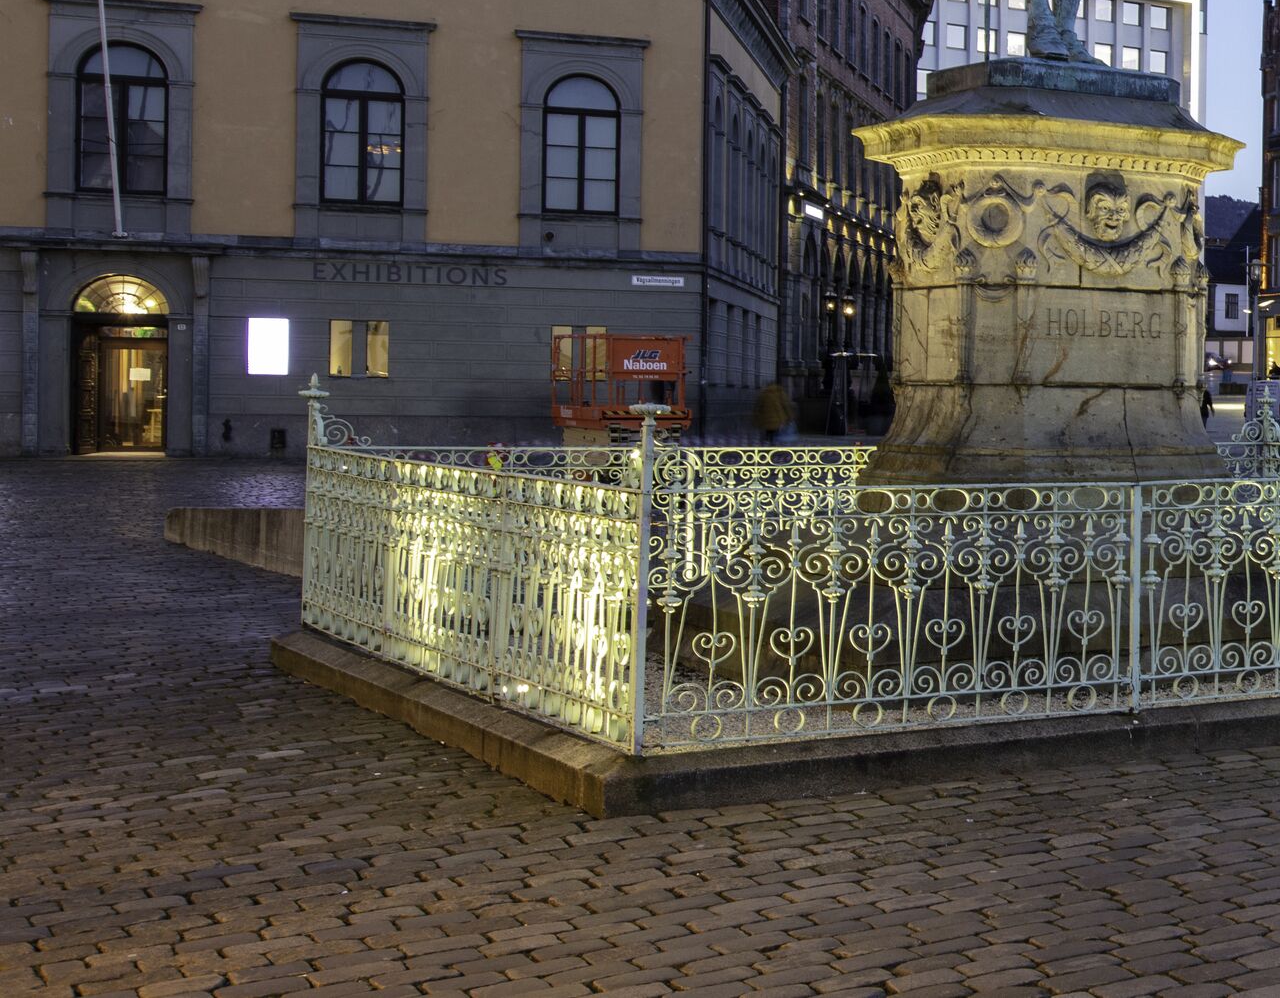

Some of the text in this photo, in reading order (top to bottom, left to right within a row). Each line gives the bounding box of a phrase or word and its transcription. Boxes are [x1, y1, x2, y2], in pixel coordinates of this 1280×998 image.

[312, 262, 508, 286] EXHIBITIONS
[1046, 307, 1161, 339] HOLBERG
[631, 349, 661, 361] JLG
[623, 359, 667, 370] Naboen
